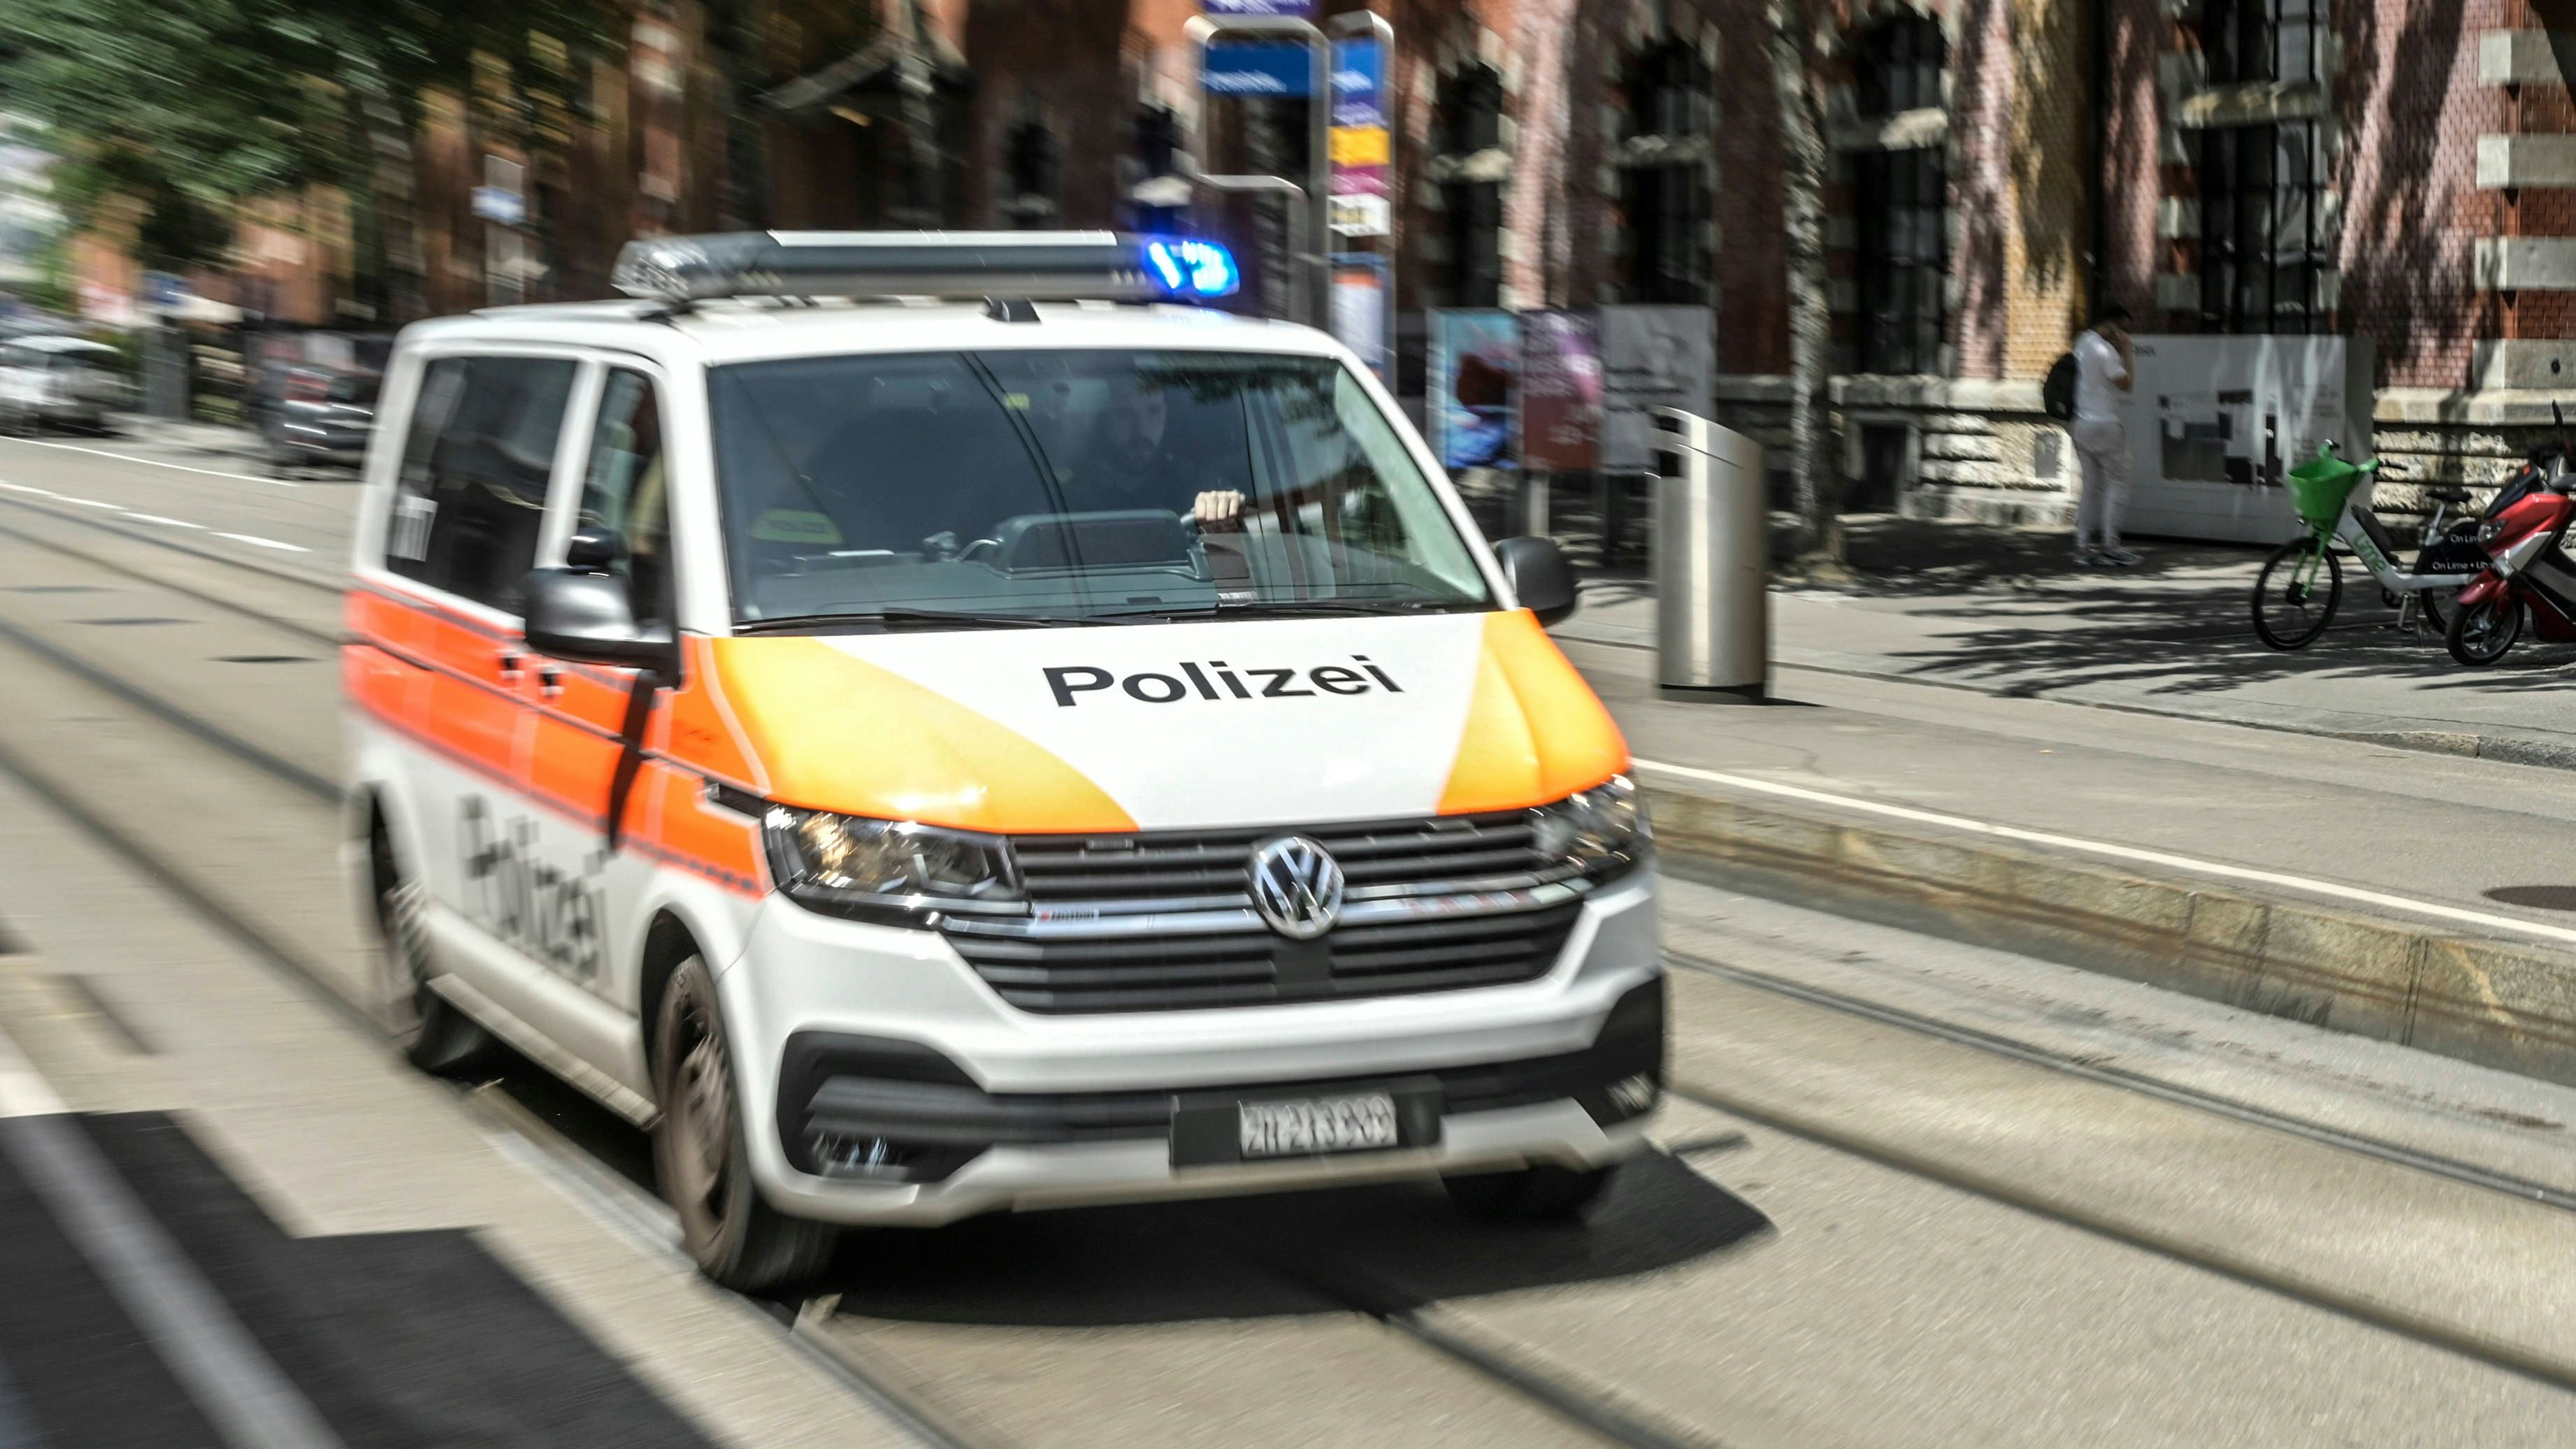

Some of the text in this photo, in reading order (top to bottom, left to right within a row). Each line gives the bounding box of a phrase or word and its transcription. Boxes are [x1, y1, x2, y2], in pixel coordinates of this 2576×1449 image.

[2450, 534, 2463, 543] On
[2353, 533, 2387, 572] Lime
[2433, 561, 2446, 570] On
[2447, 561, 2468, 570] Lime
[1042, 654, 1405, 707] Polizei
